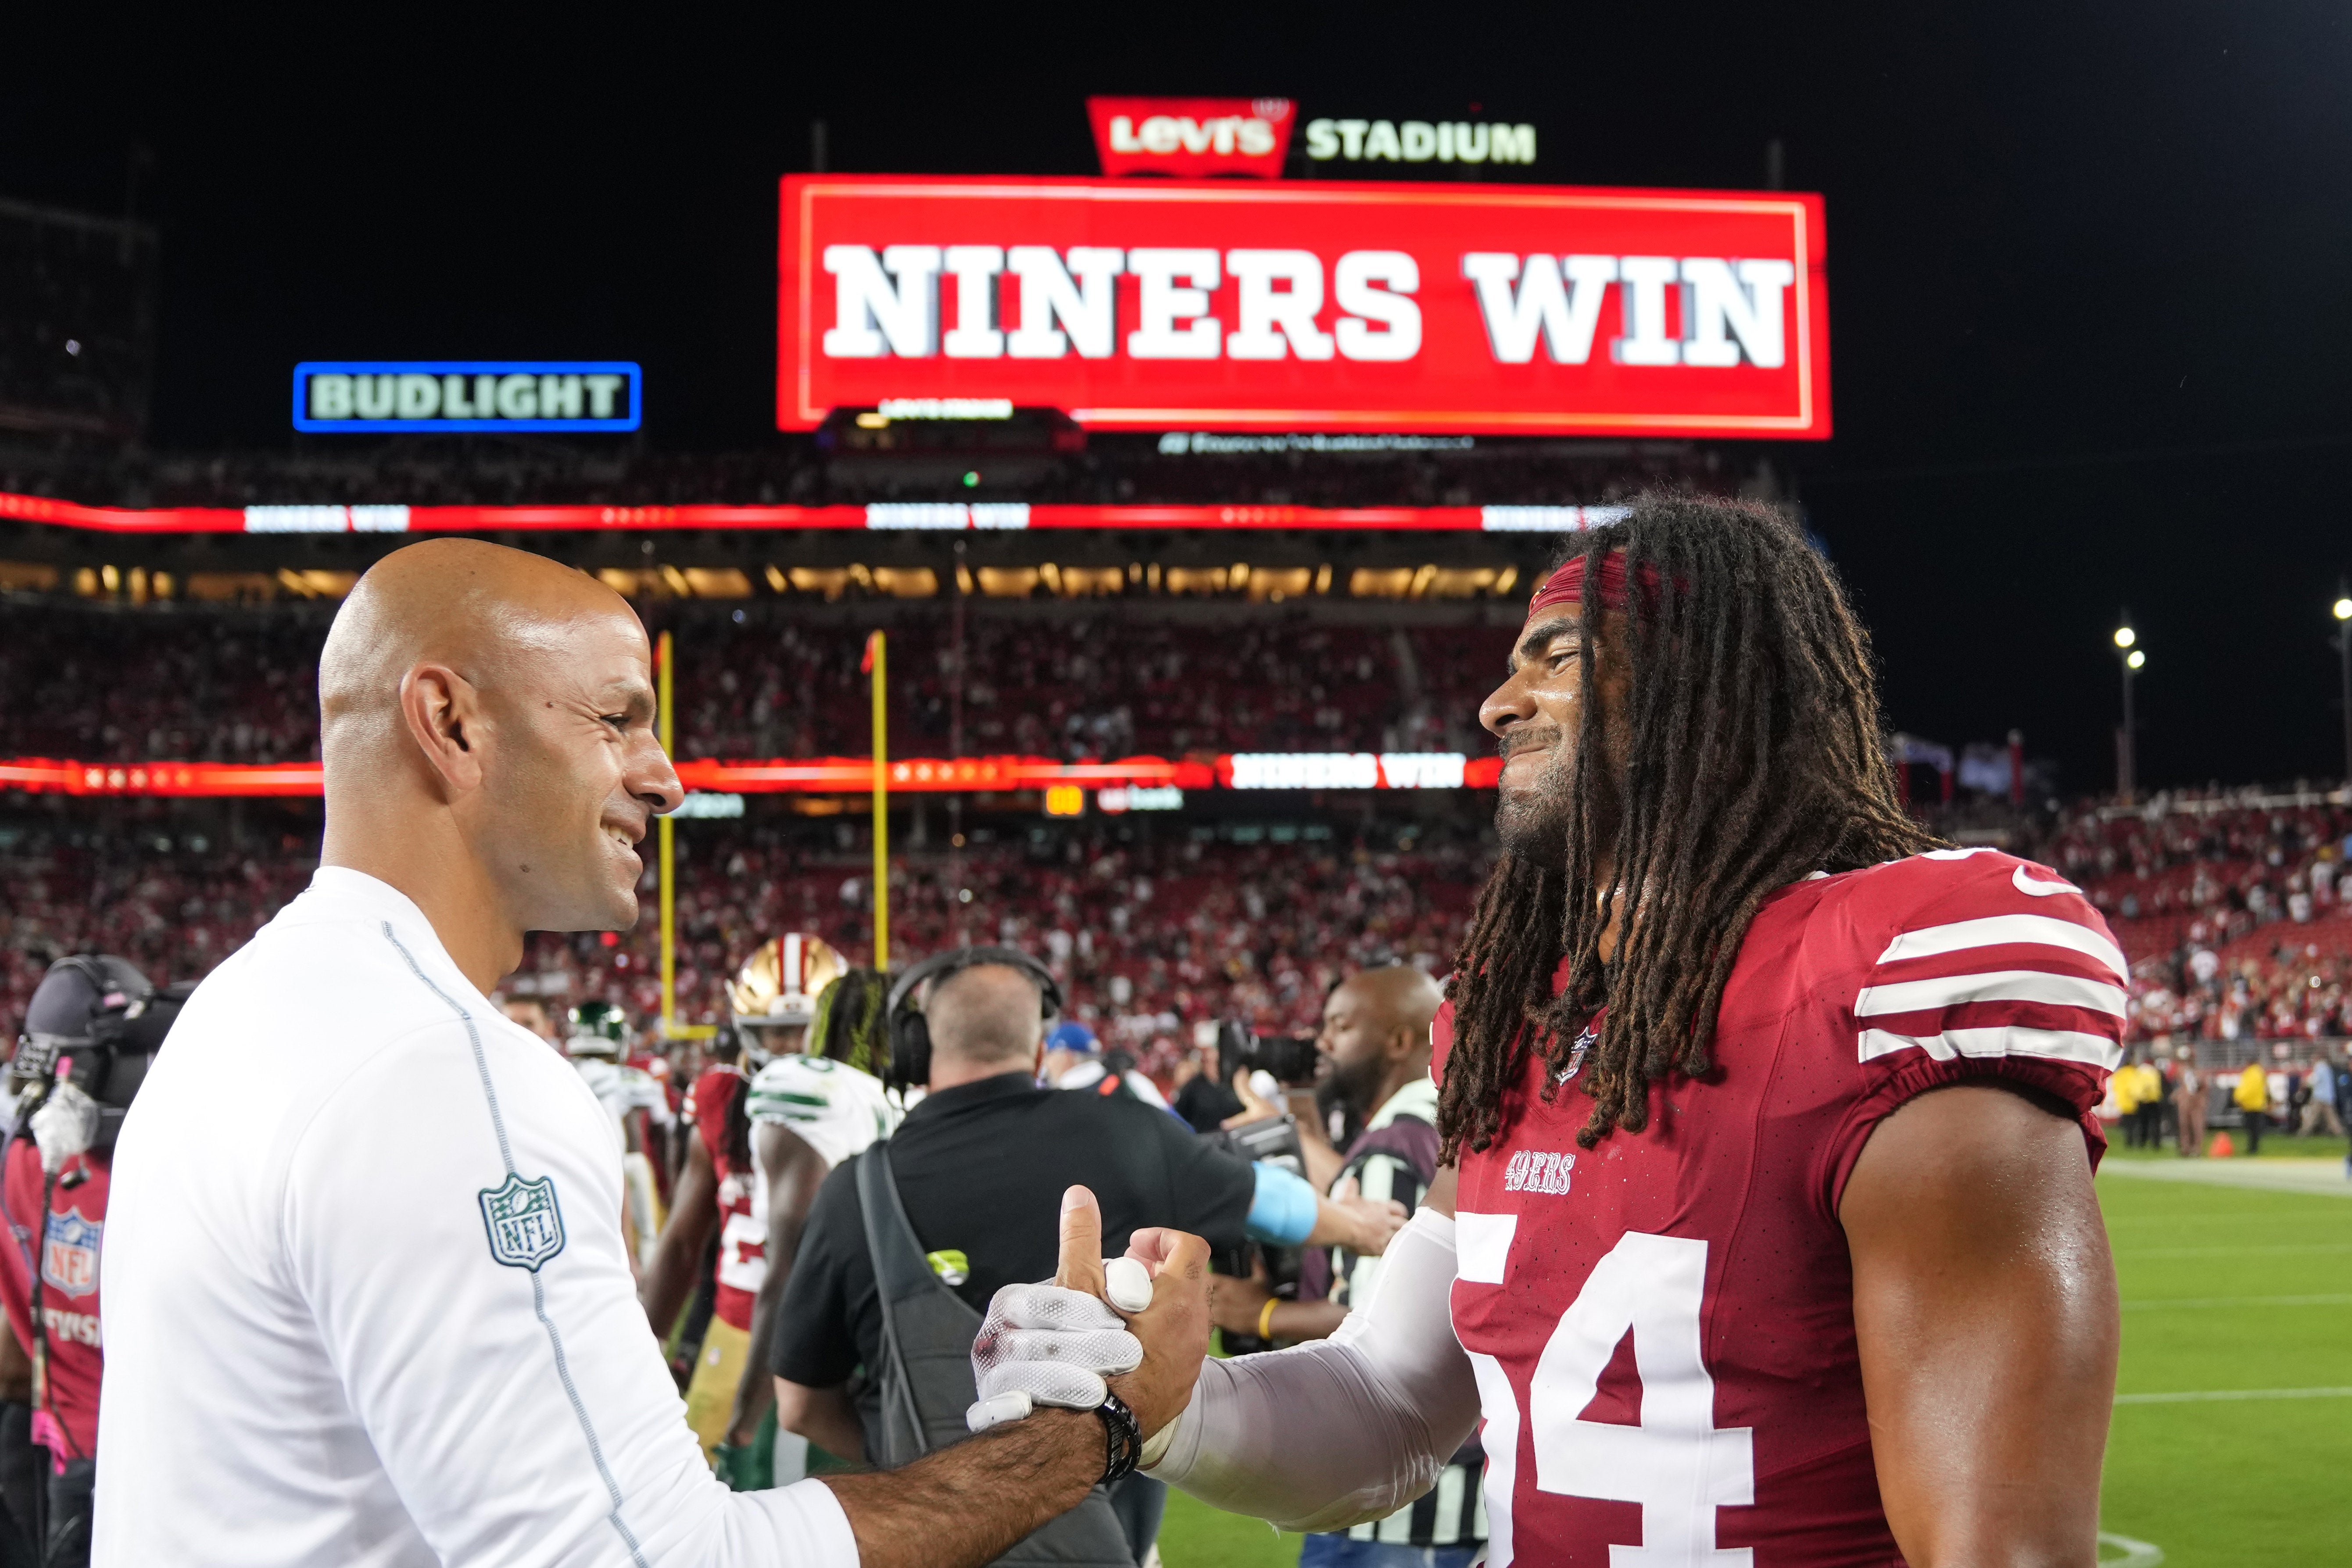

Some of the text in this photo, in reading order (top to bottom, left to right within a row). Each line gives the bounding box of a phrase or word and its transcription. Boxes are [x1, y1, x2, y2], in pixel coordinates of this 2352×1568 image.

[1306, 118, 1536, 163] STADIUM
[822, 244, 1795, 369] NINERS WIN
[1504, 1149, 1576, 1195] 49ERS
[498, 1210, 555, 1253] NFL
[50, 1244, 93, 1285] NFL
